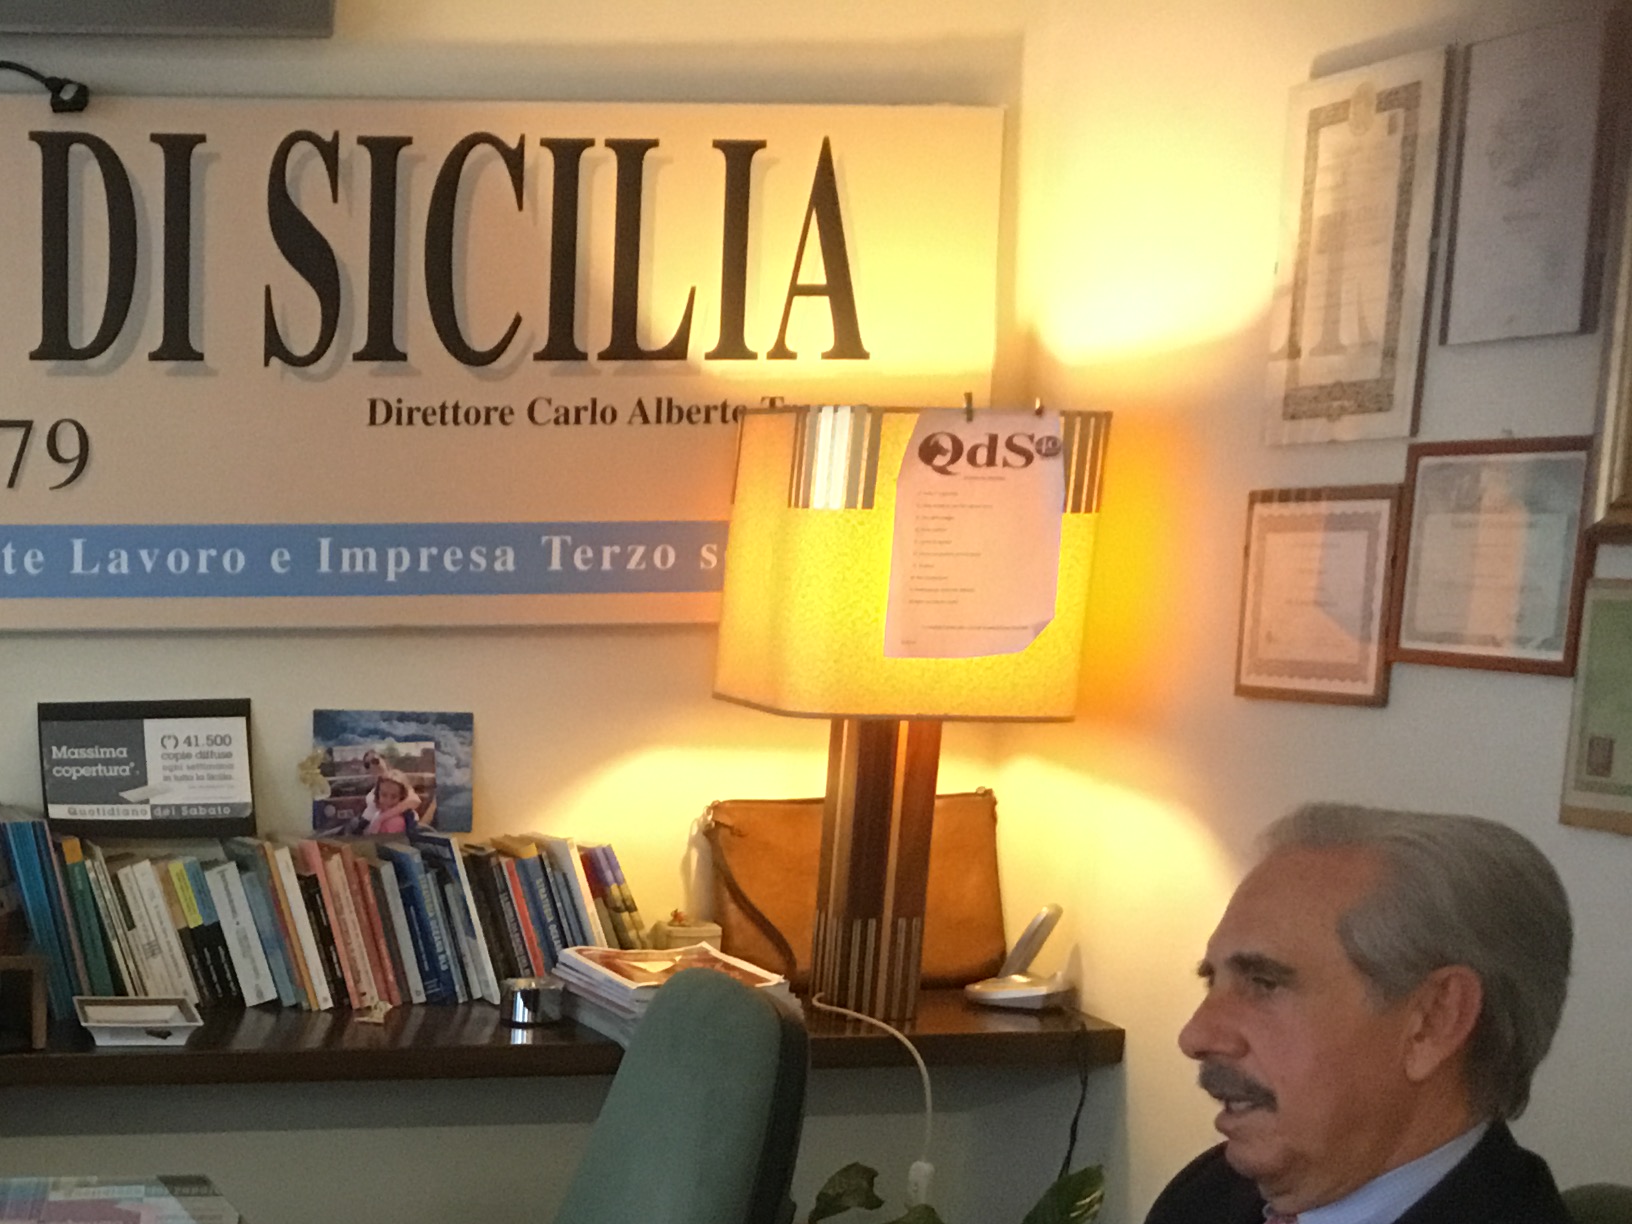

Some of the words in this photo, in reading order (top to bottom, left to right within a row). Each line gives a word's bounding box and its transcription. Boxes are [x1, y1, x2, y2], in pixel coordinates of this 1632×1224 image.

[28, 130, 207, 362] DI
[263, 129, 870, 368] SICILIA
[366, 397, 515, 427] Direttore
[527, 397, 618, 427] Carlo
[917, 430, 1036, 476] QdS
[70, 539, 247, 576] Lavoro
[271, 550, 293, 575] e
[317, 537, 518, 582] Impresa
[542, 536, 676, 573] Terzo
[51, 745, 128, 760] Massima
[67, 805, 148, 817] Quotidiano
